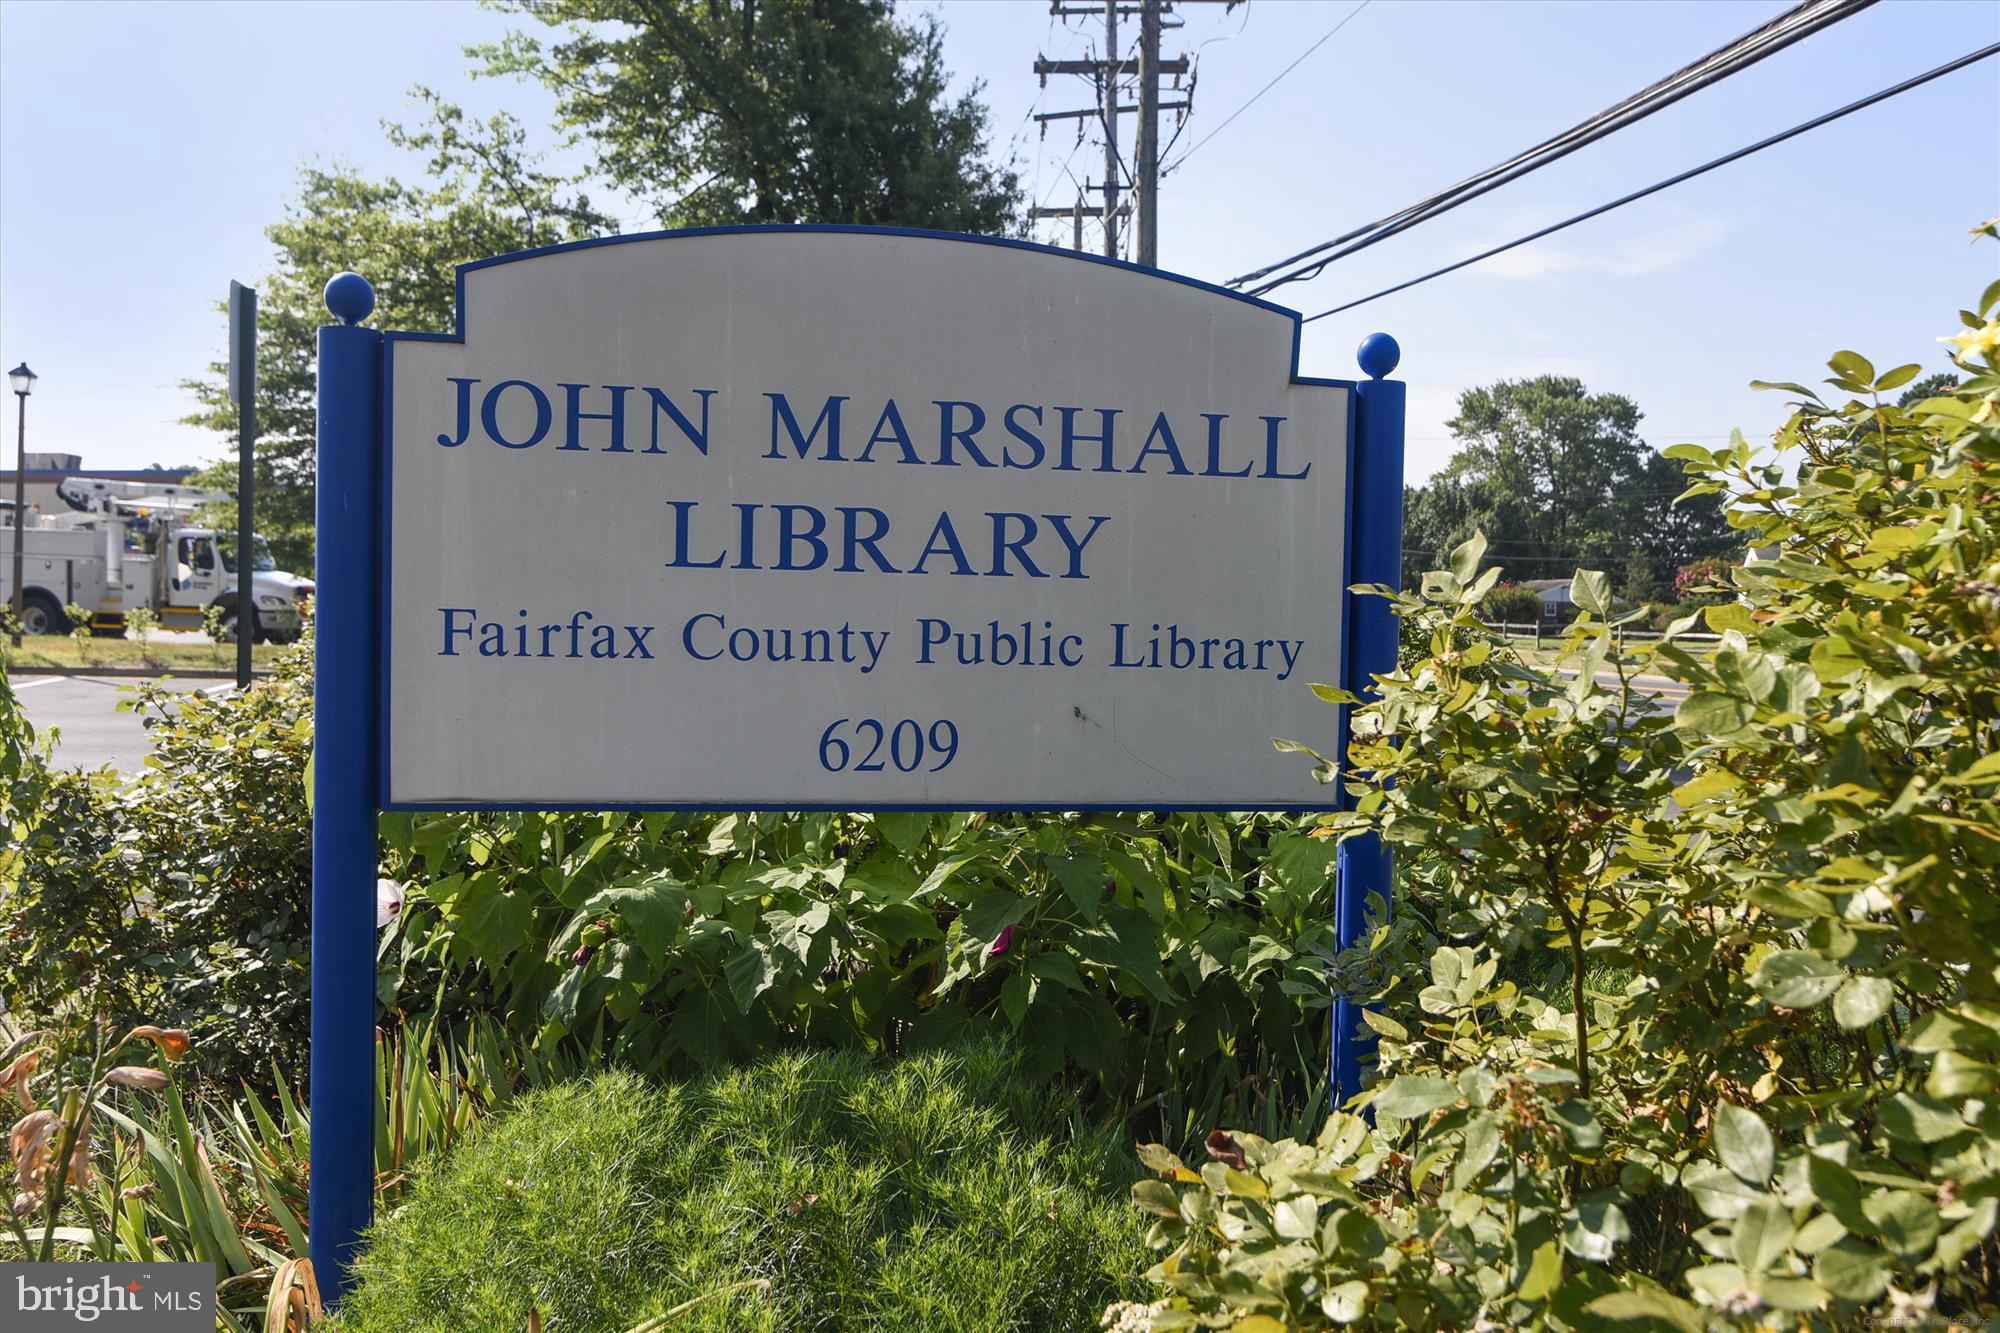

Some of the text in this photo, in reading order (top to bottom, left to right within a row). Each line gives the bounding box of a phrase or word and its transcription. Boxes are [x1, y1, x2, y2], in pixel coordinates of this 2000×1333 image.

[438, 378, 1312, 481] JOHN MARSHALL
[665, 501, 1112, 580] LIBRARY
[438, 608, 1306, 682] Fairfax County Public Library
[819, 718, 960, 774] 6209
